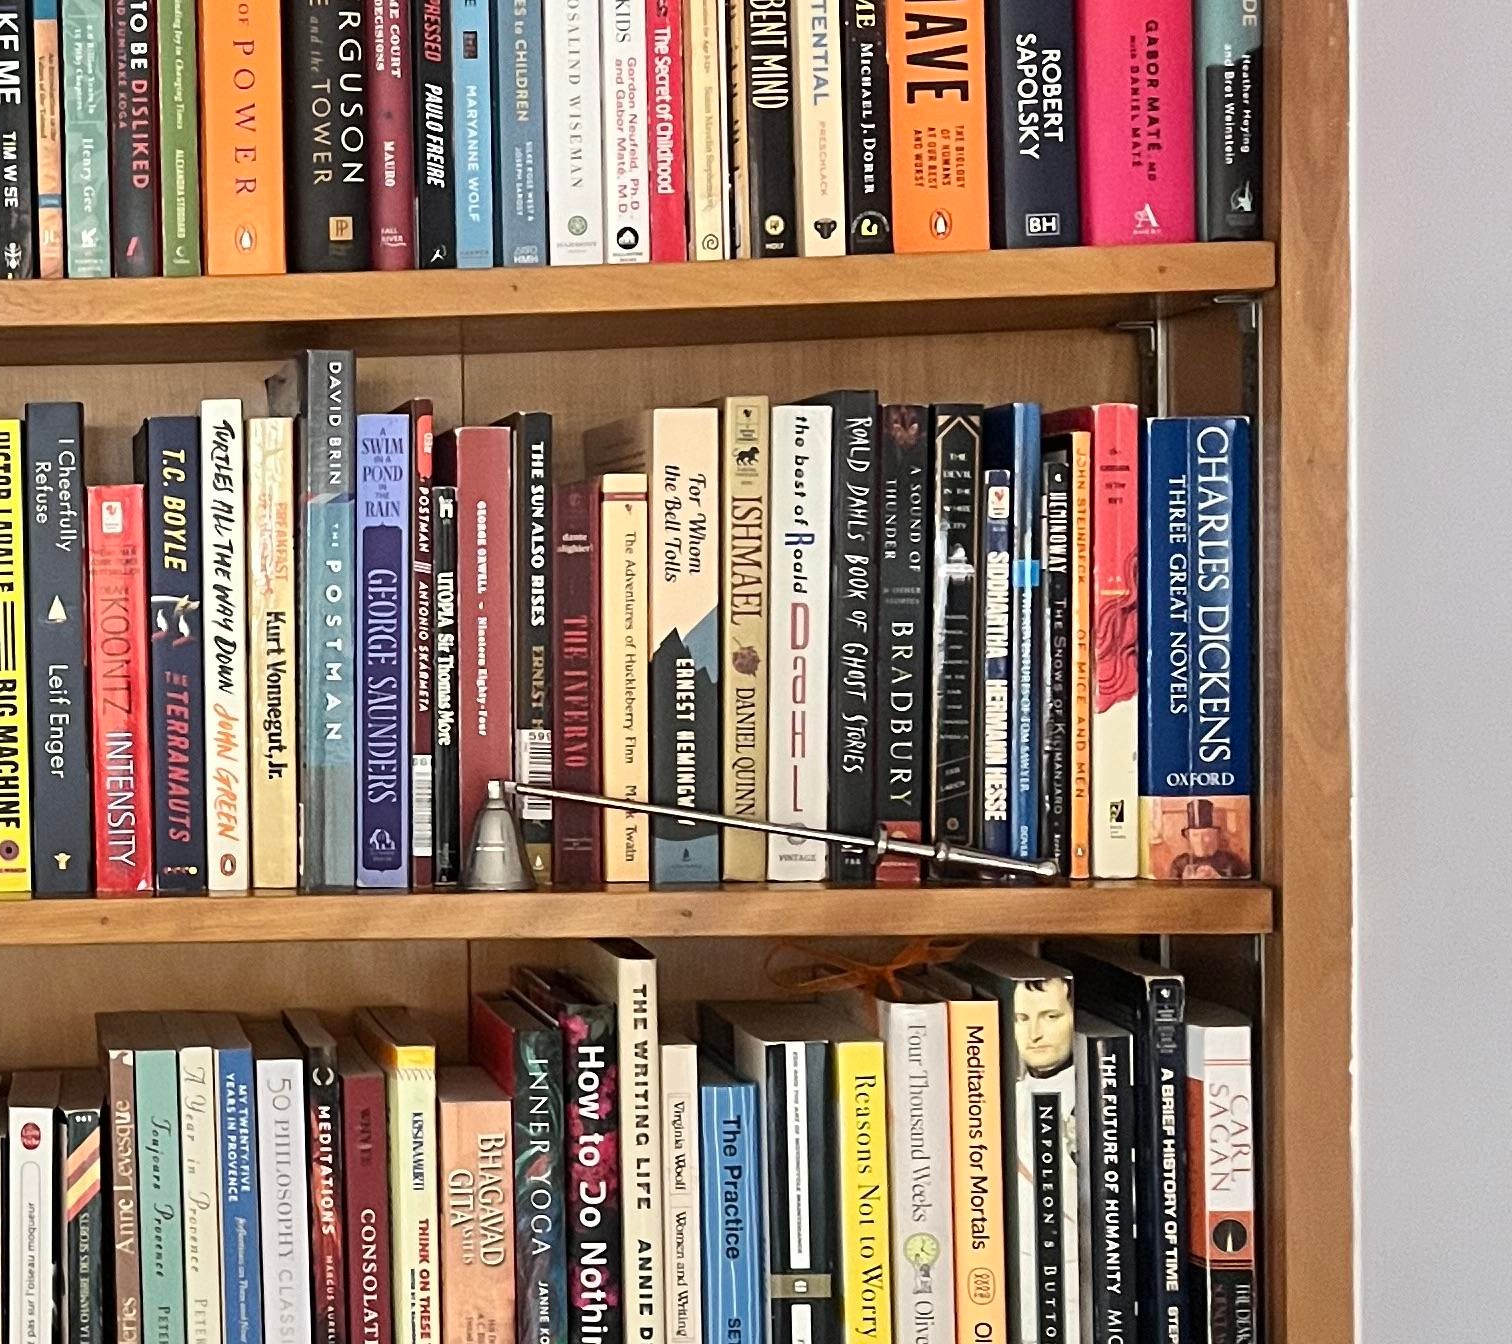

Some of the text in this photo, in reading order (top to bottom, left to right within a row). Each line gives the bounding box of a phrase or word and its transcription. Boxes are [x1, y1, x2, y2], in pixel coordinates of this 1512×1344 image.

[129, 0, 148, 34] TO
[130, 41, 148, 69] BE
[131, 79, 150, 189] DISLIKED
[425, 84, 445, 187] PAULO FREIRE
[1017, 34, 1040, 160] SAPOLSKY
[1041, 48, 1063, 142] ROBERT
[329, 362, 342, 485] DAVID BRIN
[35, 461, 53, 524] Refuse
[57, 450, 76, 552] Cheerfully
[664, 465, 682, 583] the Bell Tolls
[689, 474, 707, 575] For Whom
[1169, 475, 1186, 714] THREE GREAT NOVELS
[1196, 426, 1231, 762] CHARLES DICKENS
[45, 664, 70, 779] Leif Enger
[367, 569, 397, 803] GEORGE SAUNDERS
[1166, 772, 1235, 785] OXFORD
[576, 1045, 607, 1126] How
[966, 1025, 990, 1249] Meditations for Mortals
[578, 1133, 604, 1167] to
[722, 1117, 743, 1259] The Practice
